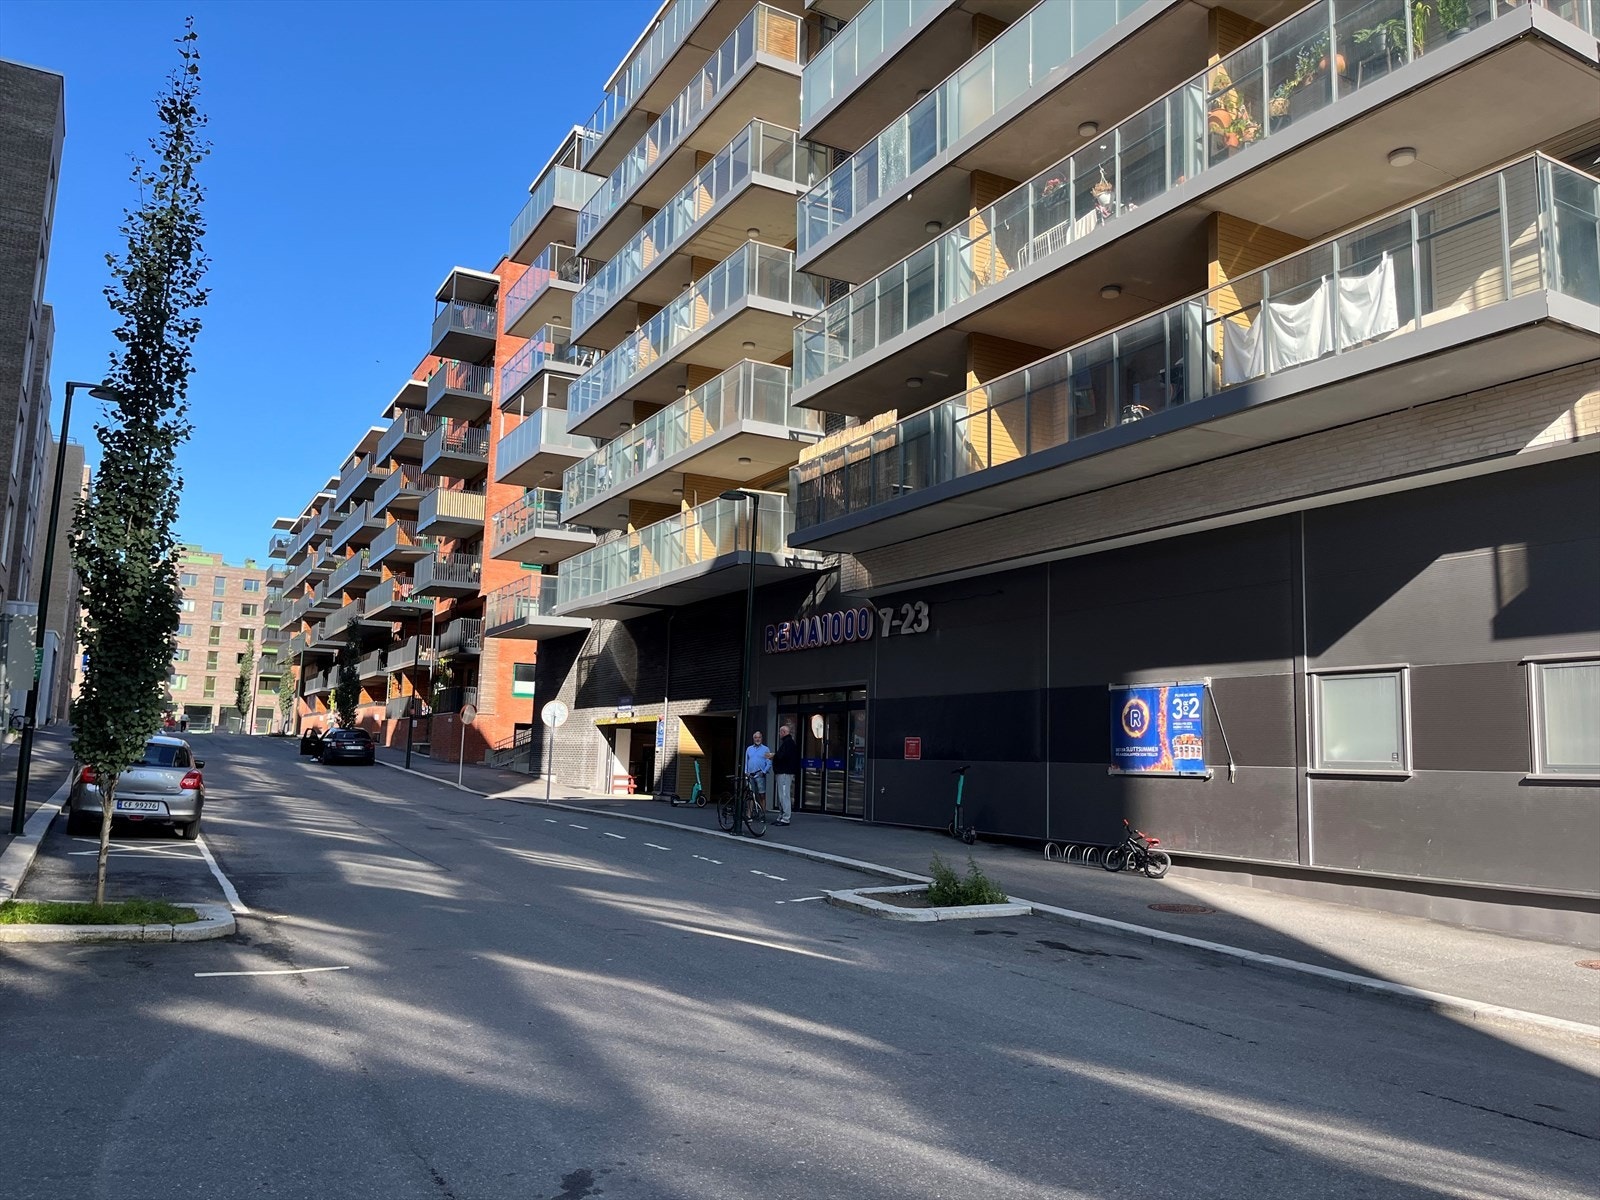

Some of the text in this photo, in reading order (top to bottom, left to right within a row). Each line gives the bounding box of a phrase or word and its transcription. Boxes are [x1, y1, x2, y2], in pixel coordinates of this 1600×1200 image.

[879, 601, 930, 638] 7-23
[1130, 709, 1141, 727] R
[1172, 697, 1183, 720] 3
[1189, 697, 1200, 719] 2
